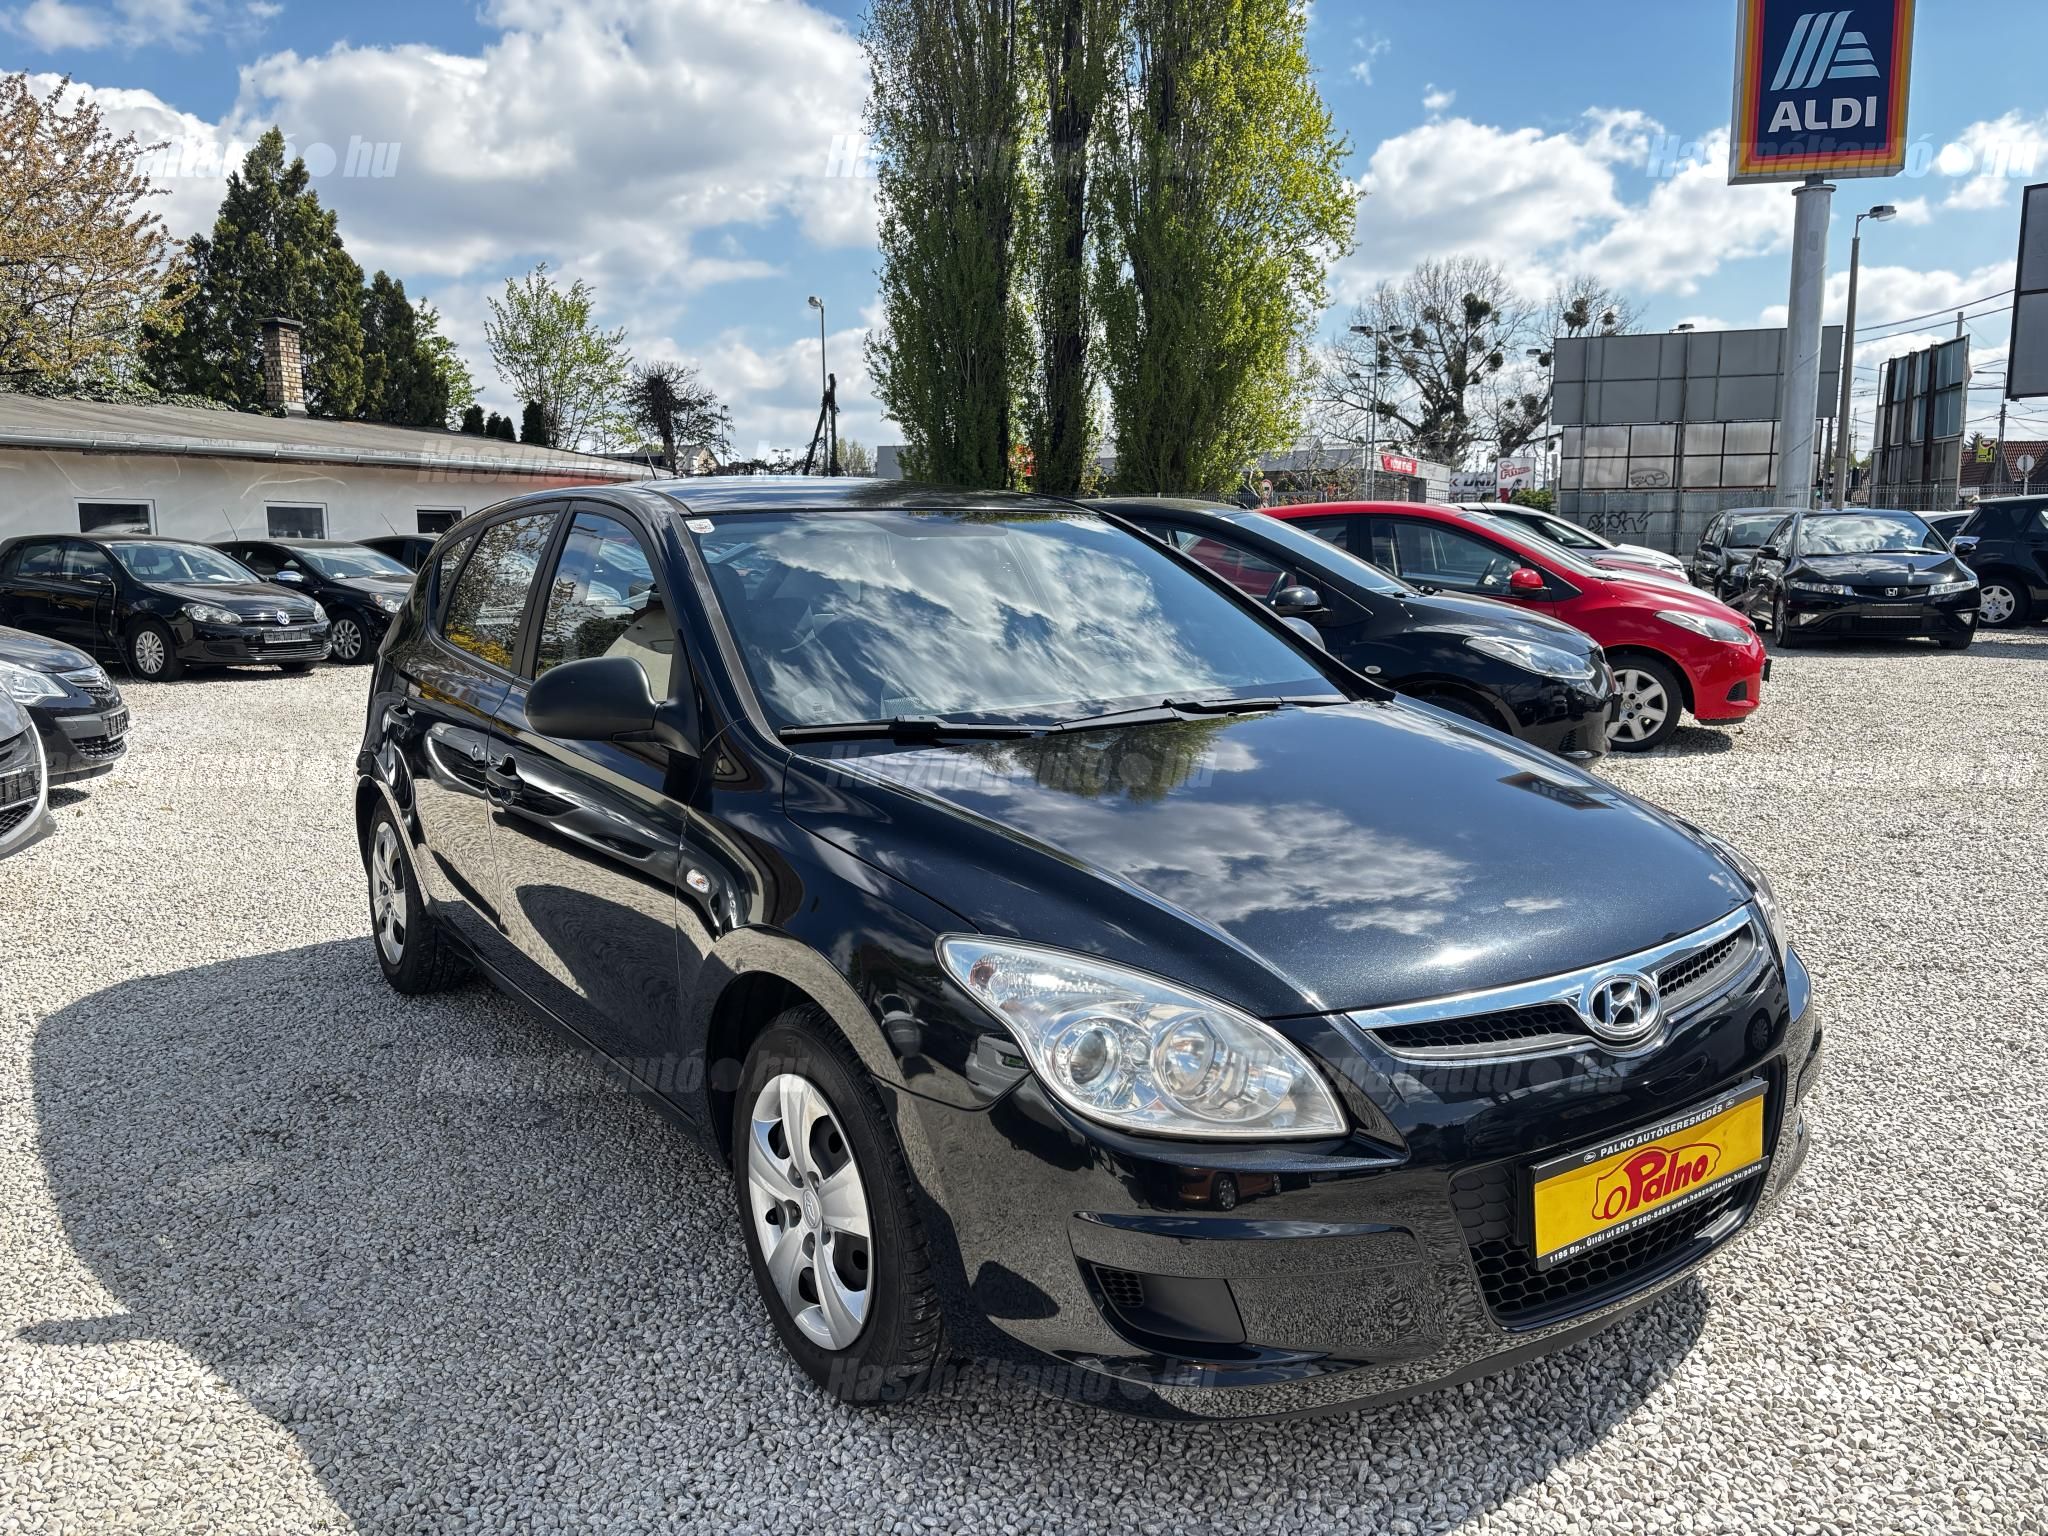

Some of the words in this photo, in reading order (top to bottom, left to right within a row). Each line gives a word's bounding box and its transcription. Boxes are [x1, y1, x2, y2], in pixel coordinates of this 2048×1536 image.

[1767, 95, 1877, 133] ALDI
[1600, 1138, 1635, 1157] PALNO
[1636, 1104, 1723, 1144] AUTÓKERESKEDÉS
[1623, 1150, 1709, 1212] Palno
